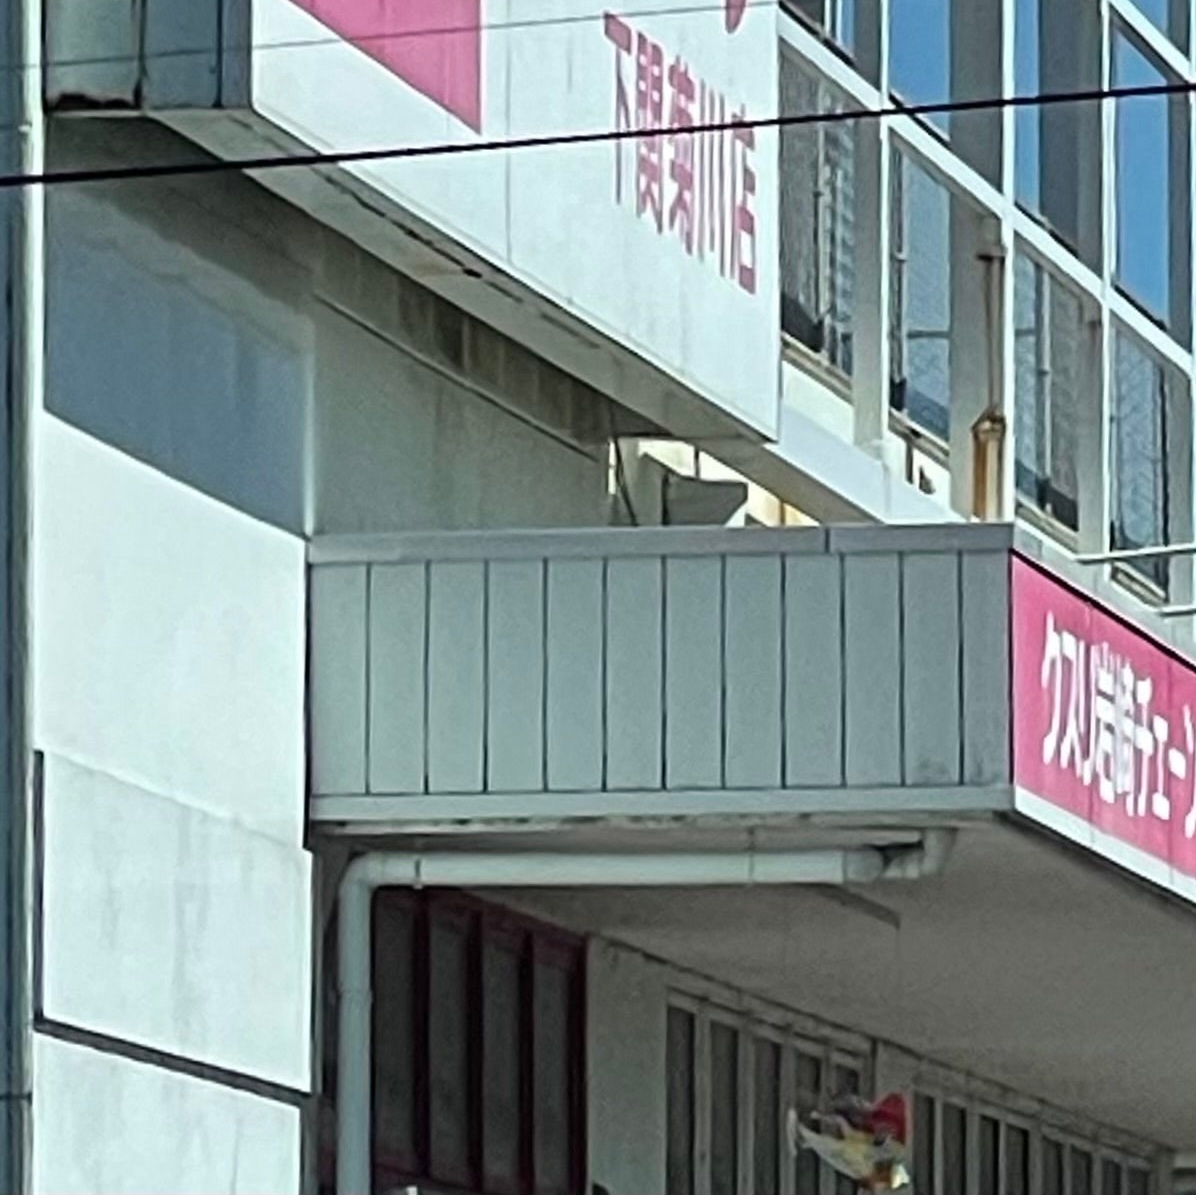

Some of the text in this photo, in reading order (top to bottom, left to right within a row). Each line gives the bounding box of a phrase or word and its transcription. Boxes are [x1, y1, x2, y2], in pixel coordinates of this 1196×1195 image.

[603, 10, 756, 295] 下関菊川店
